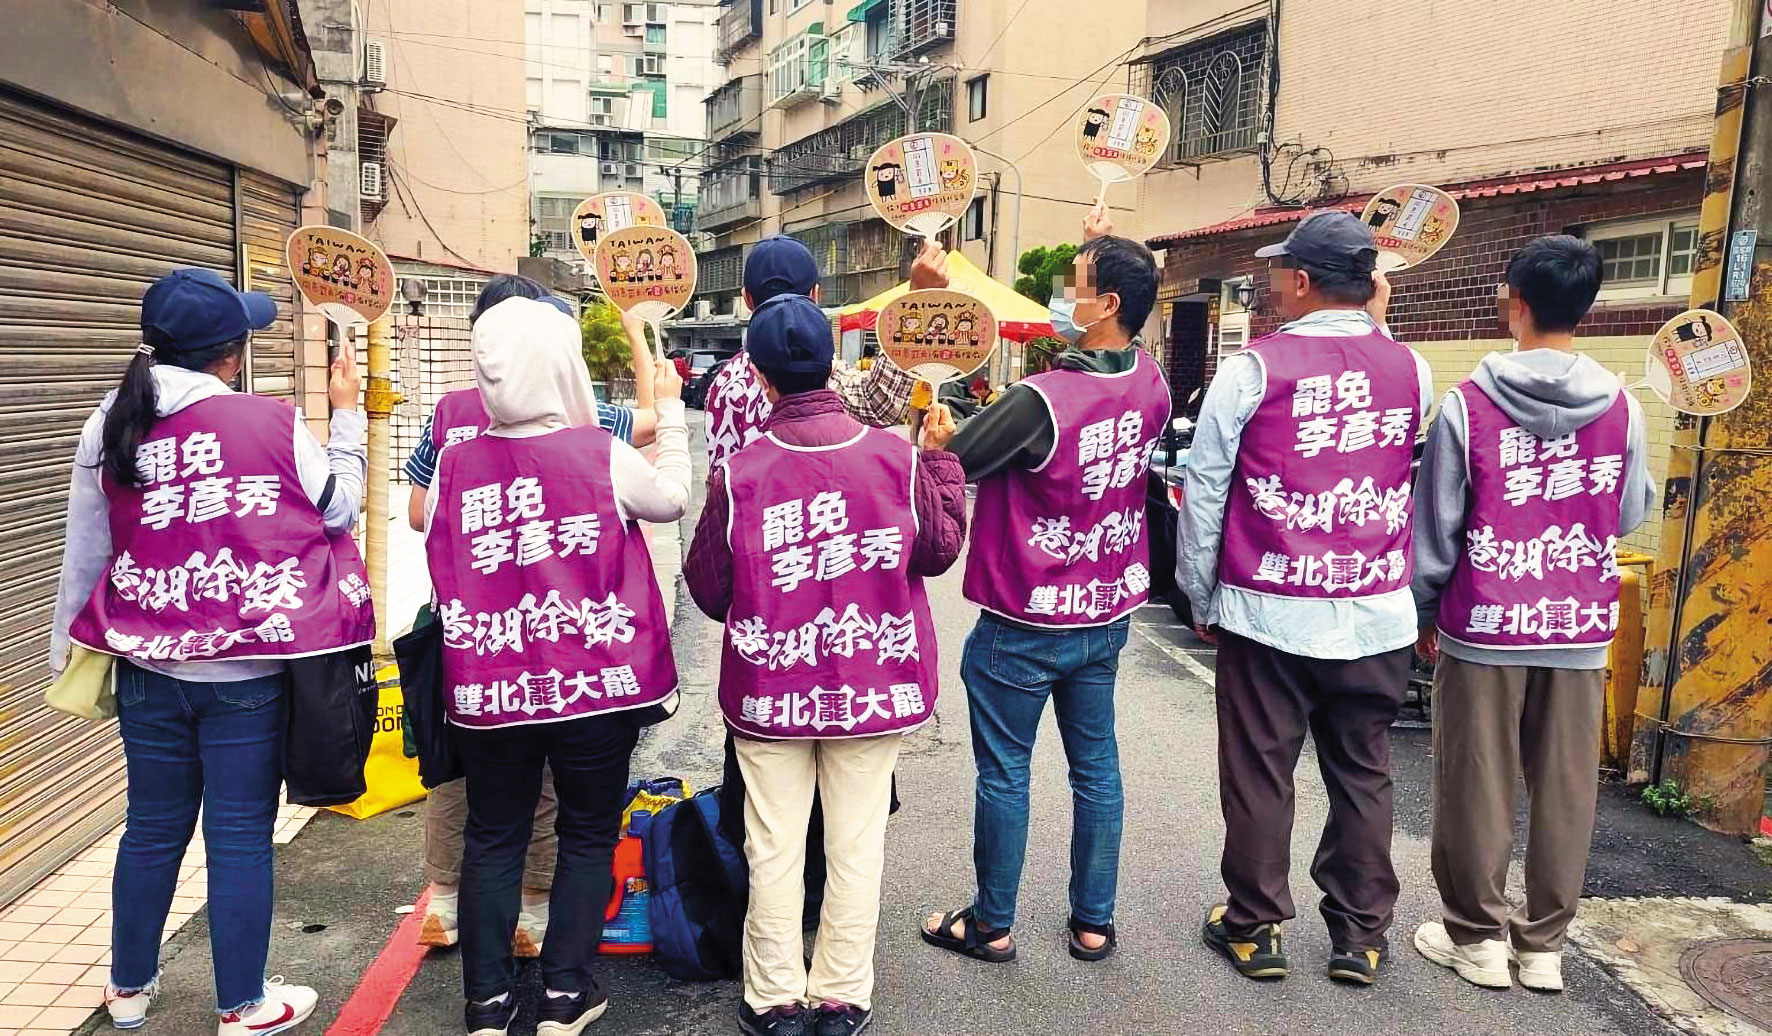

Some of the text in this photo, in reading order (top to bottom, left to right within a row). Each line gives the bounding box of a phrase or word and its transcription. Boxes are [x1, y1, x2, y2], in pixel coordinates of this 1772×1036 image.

[609, 235, 674, 249] TAIWAN!
[900, 301, 977, 311] TAIWAN!
[1292, 370, 1373, 418] 罷免
[135, 432, 224, 486] 罷免
[1078, 410, 1143, 467] 罷免
[1294, 407, 1413, 459] 李彥秀
[1498, 426, 1580, 469] 罷免
[140, 474, 282, 532] 李彥秀
[461, 476, 546, 534] 罷免
[1502, 454, 1624, 507] 李彥秀
[471, 513, 601, 575] 李彥秀
[762, 490, 849, 552] 罷免
[771, 526, 903, 594] 李彥秀
